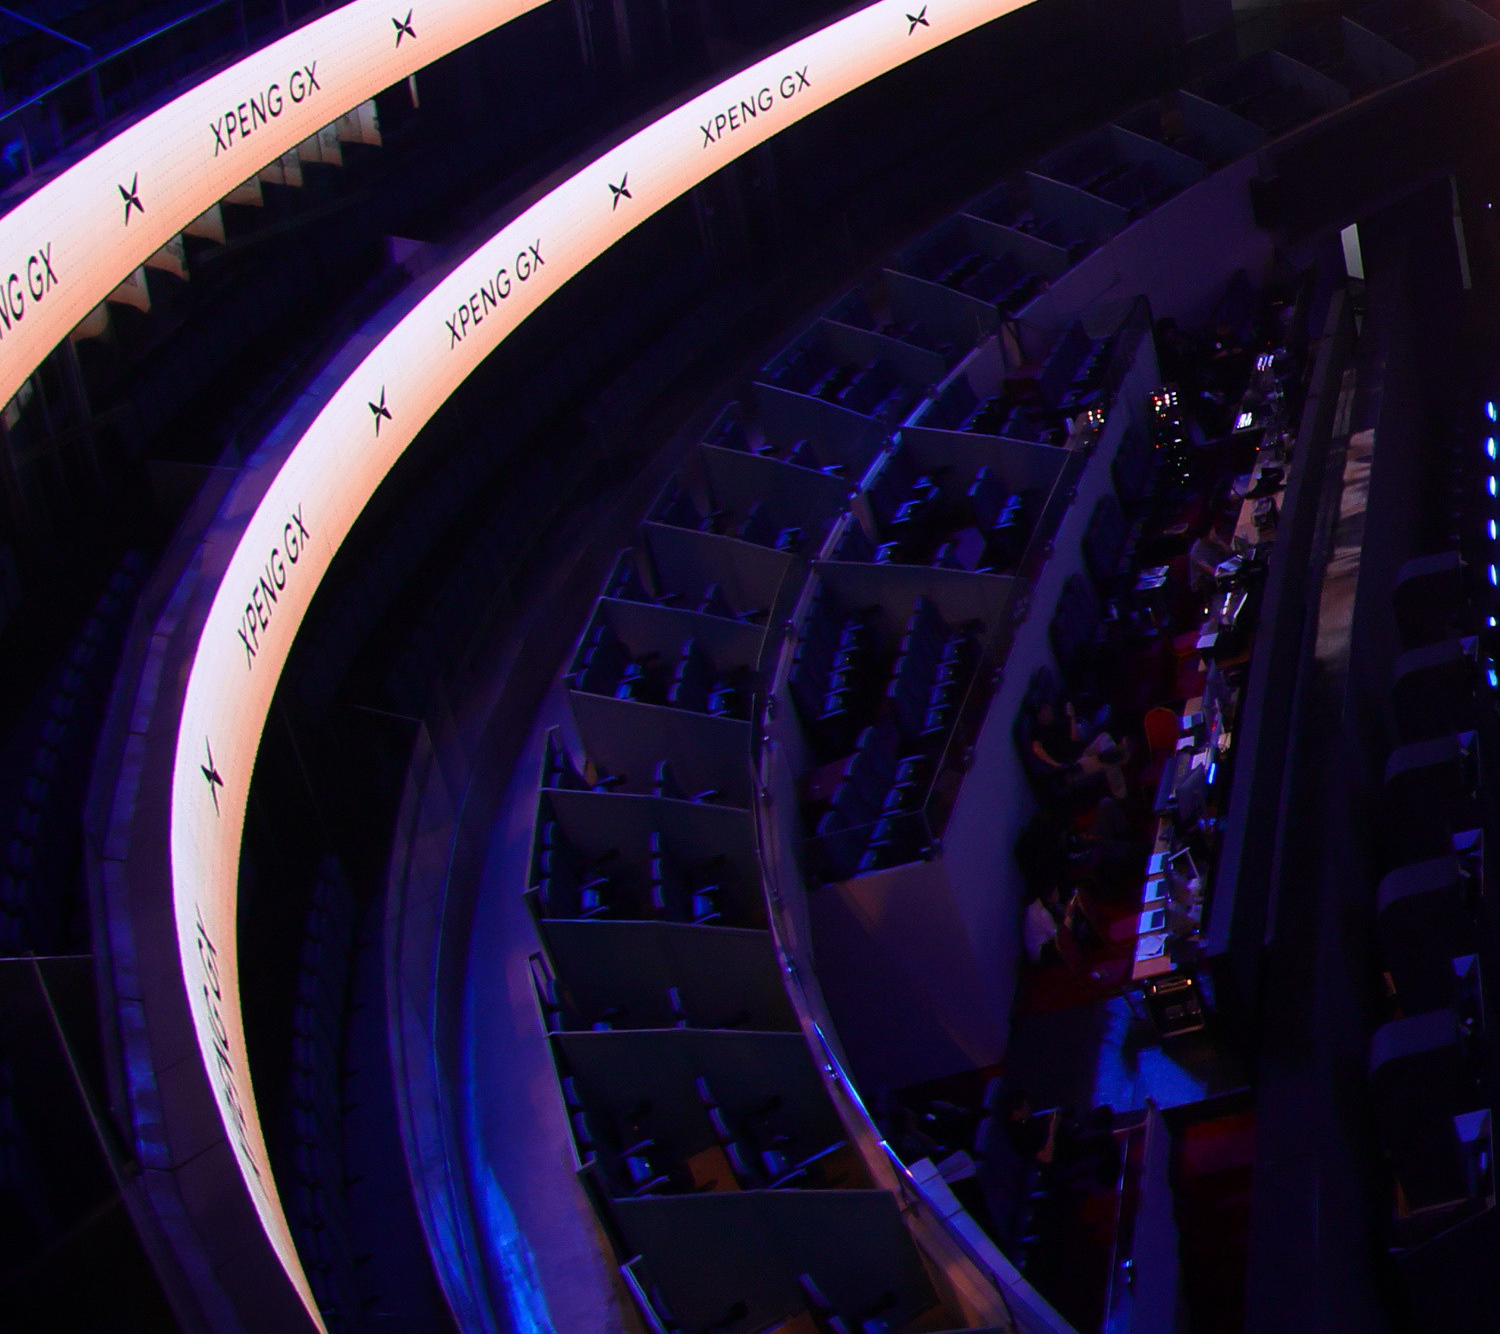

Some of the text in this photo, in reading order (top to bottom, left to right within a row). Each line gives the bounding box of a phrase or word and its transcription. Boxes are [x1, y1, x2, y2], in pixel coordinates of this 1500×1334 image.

[209, 60, 322, 158] XPENG GX
[699, 65, 812, 149] XPENG GX
[27, 241, 59, 303] GX
[445, 238, 546, 350] XPENG GX
[237, 504, 311, 671] XPENG GX
